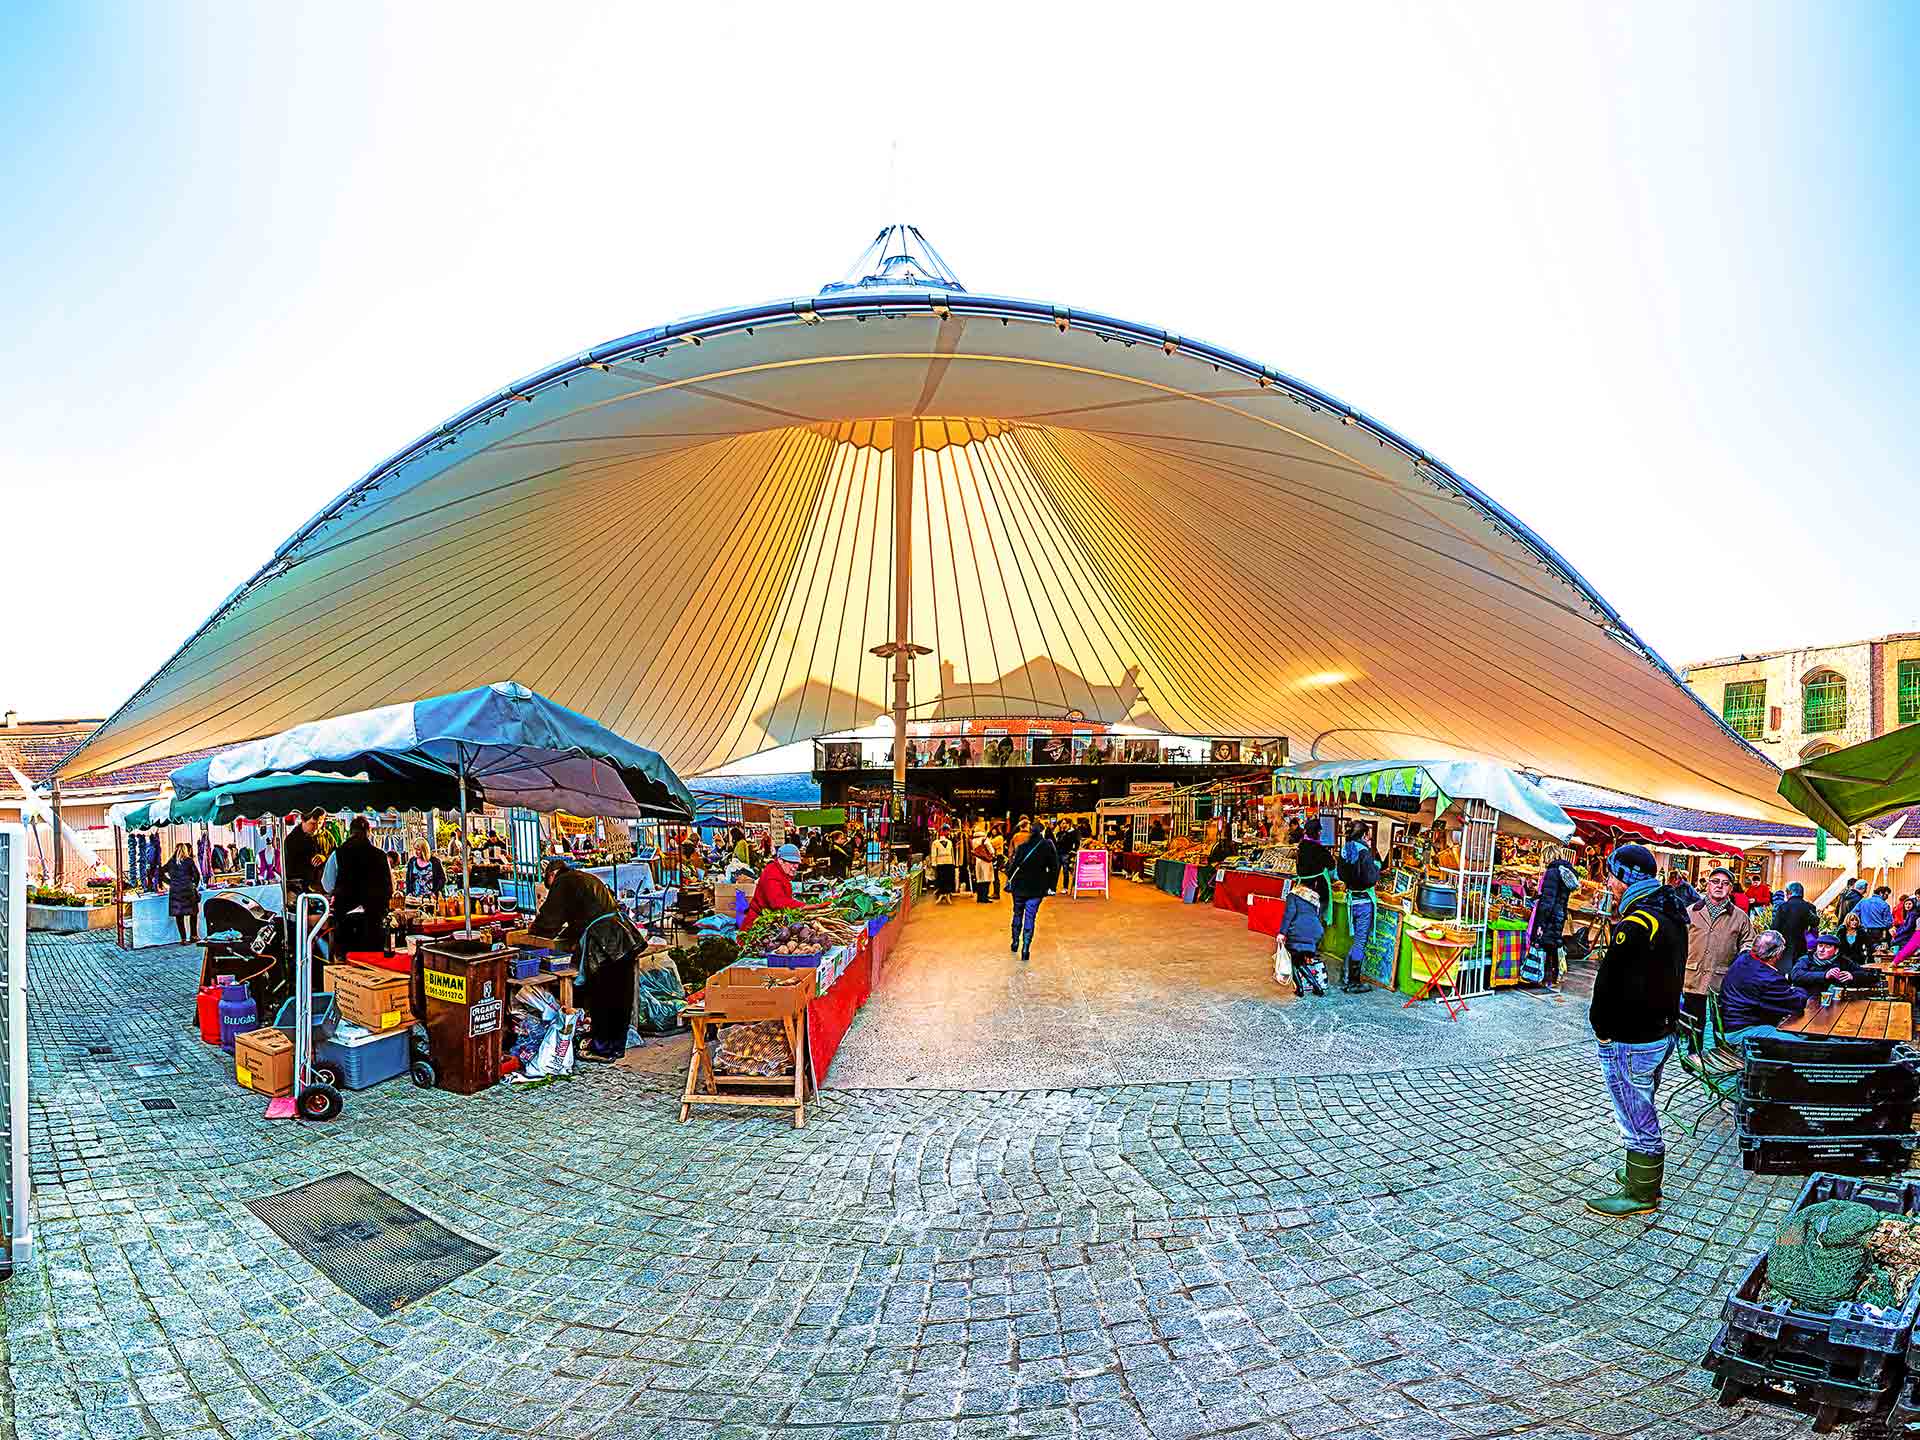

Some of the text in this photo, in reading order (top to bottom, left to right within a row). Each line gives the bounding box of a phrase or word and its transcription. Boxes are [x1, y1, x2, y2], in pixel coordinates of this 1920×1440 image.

[430, 974, 464, 990] BINMAN
[472, 1003, 500, 1016] ORGANIC
[474, 1011, 496, 1022] WASTE
